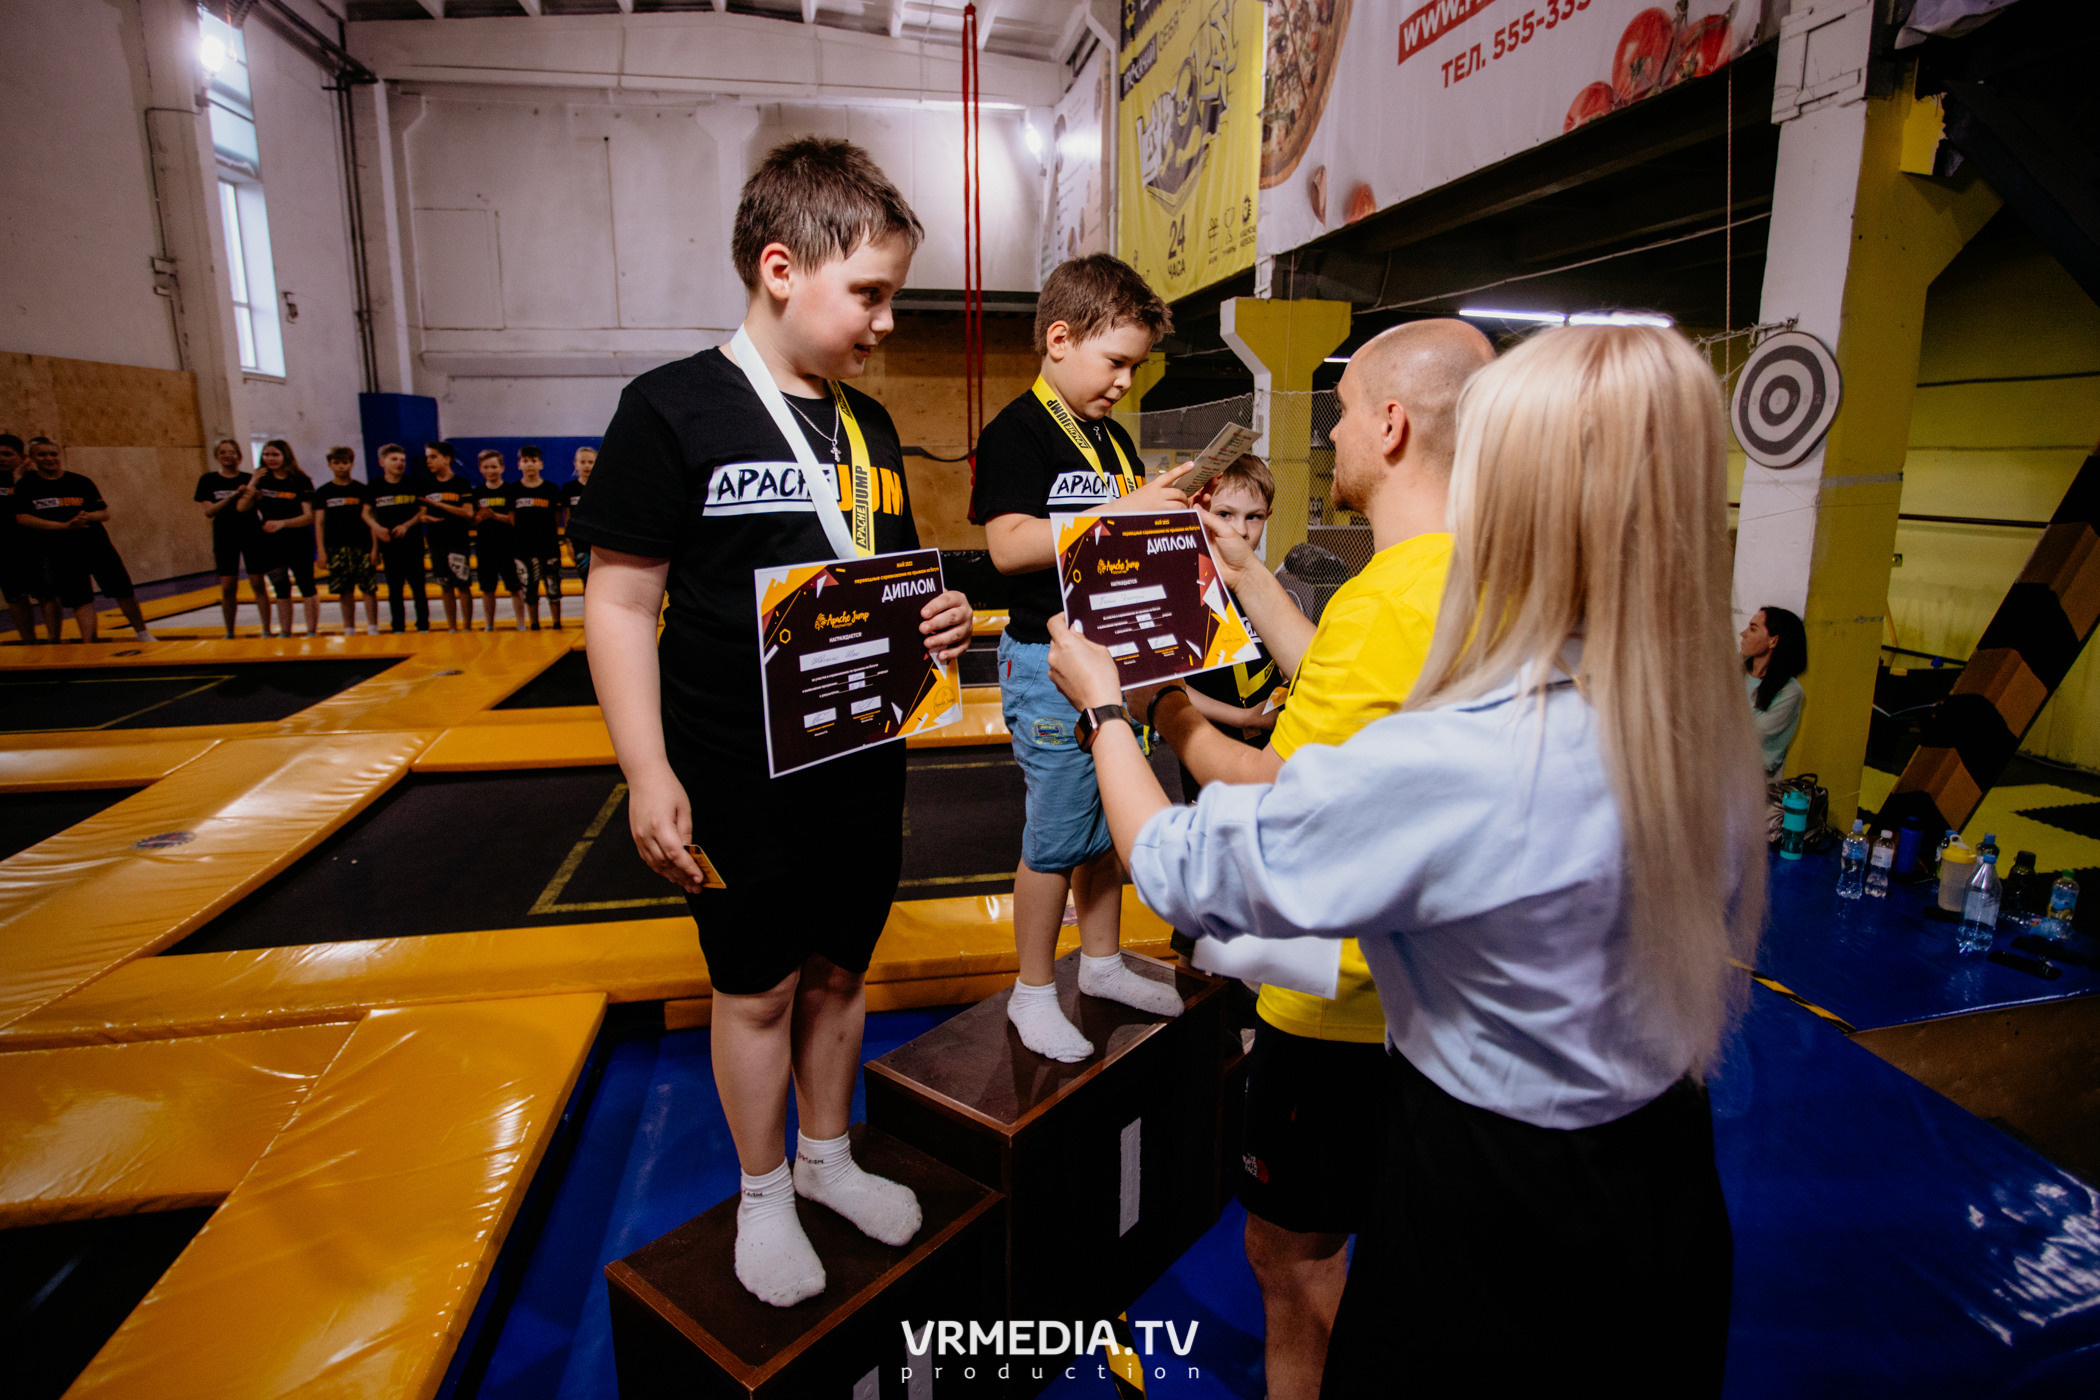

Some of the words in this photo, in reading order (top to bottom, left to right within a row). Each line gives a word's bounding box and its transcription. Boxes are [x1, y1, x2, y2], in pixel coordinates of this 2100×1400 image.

[1441, 42, 1487, 89] ТЕЛ.
[1168, 213, 1186, 260] 24
[1167, 259, 1186, 279] ЧАСА
[854, 465, 869, 506] JUMP
[855, 505, 868, 550] APACHE
[1147, 534, 1197, 555] ДИПЛОМ
[881, 577, 936, 603] ДИПЛОМ
